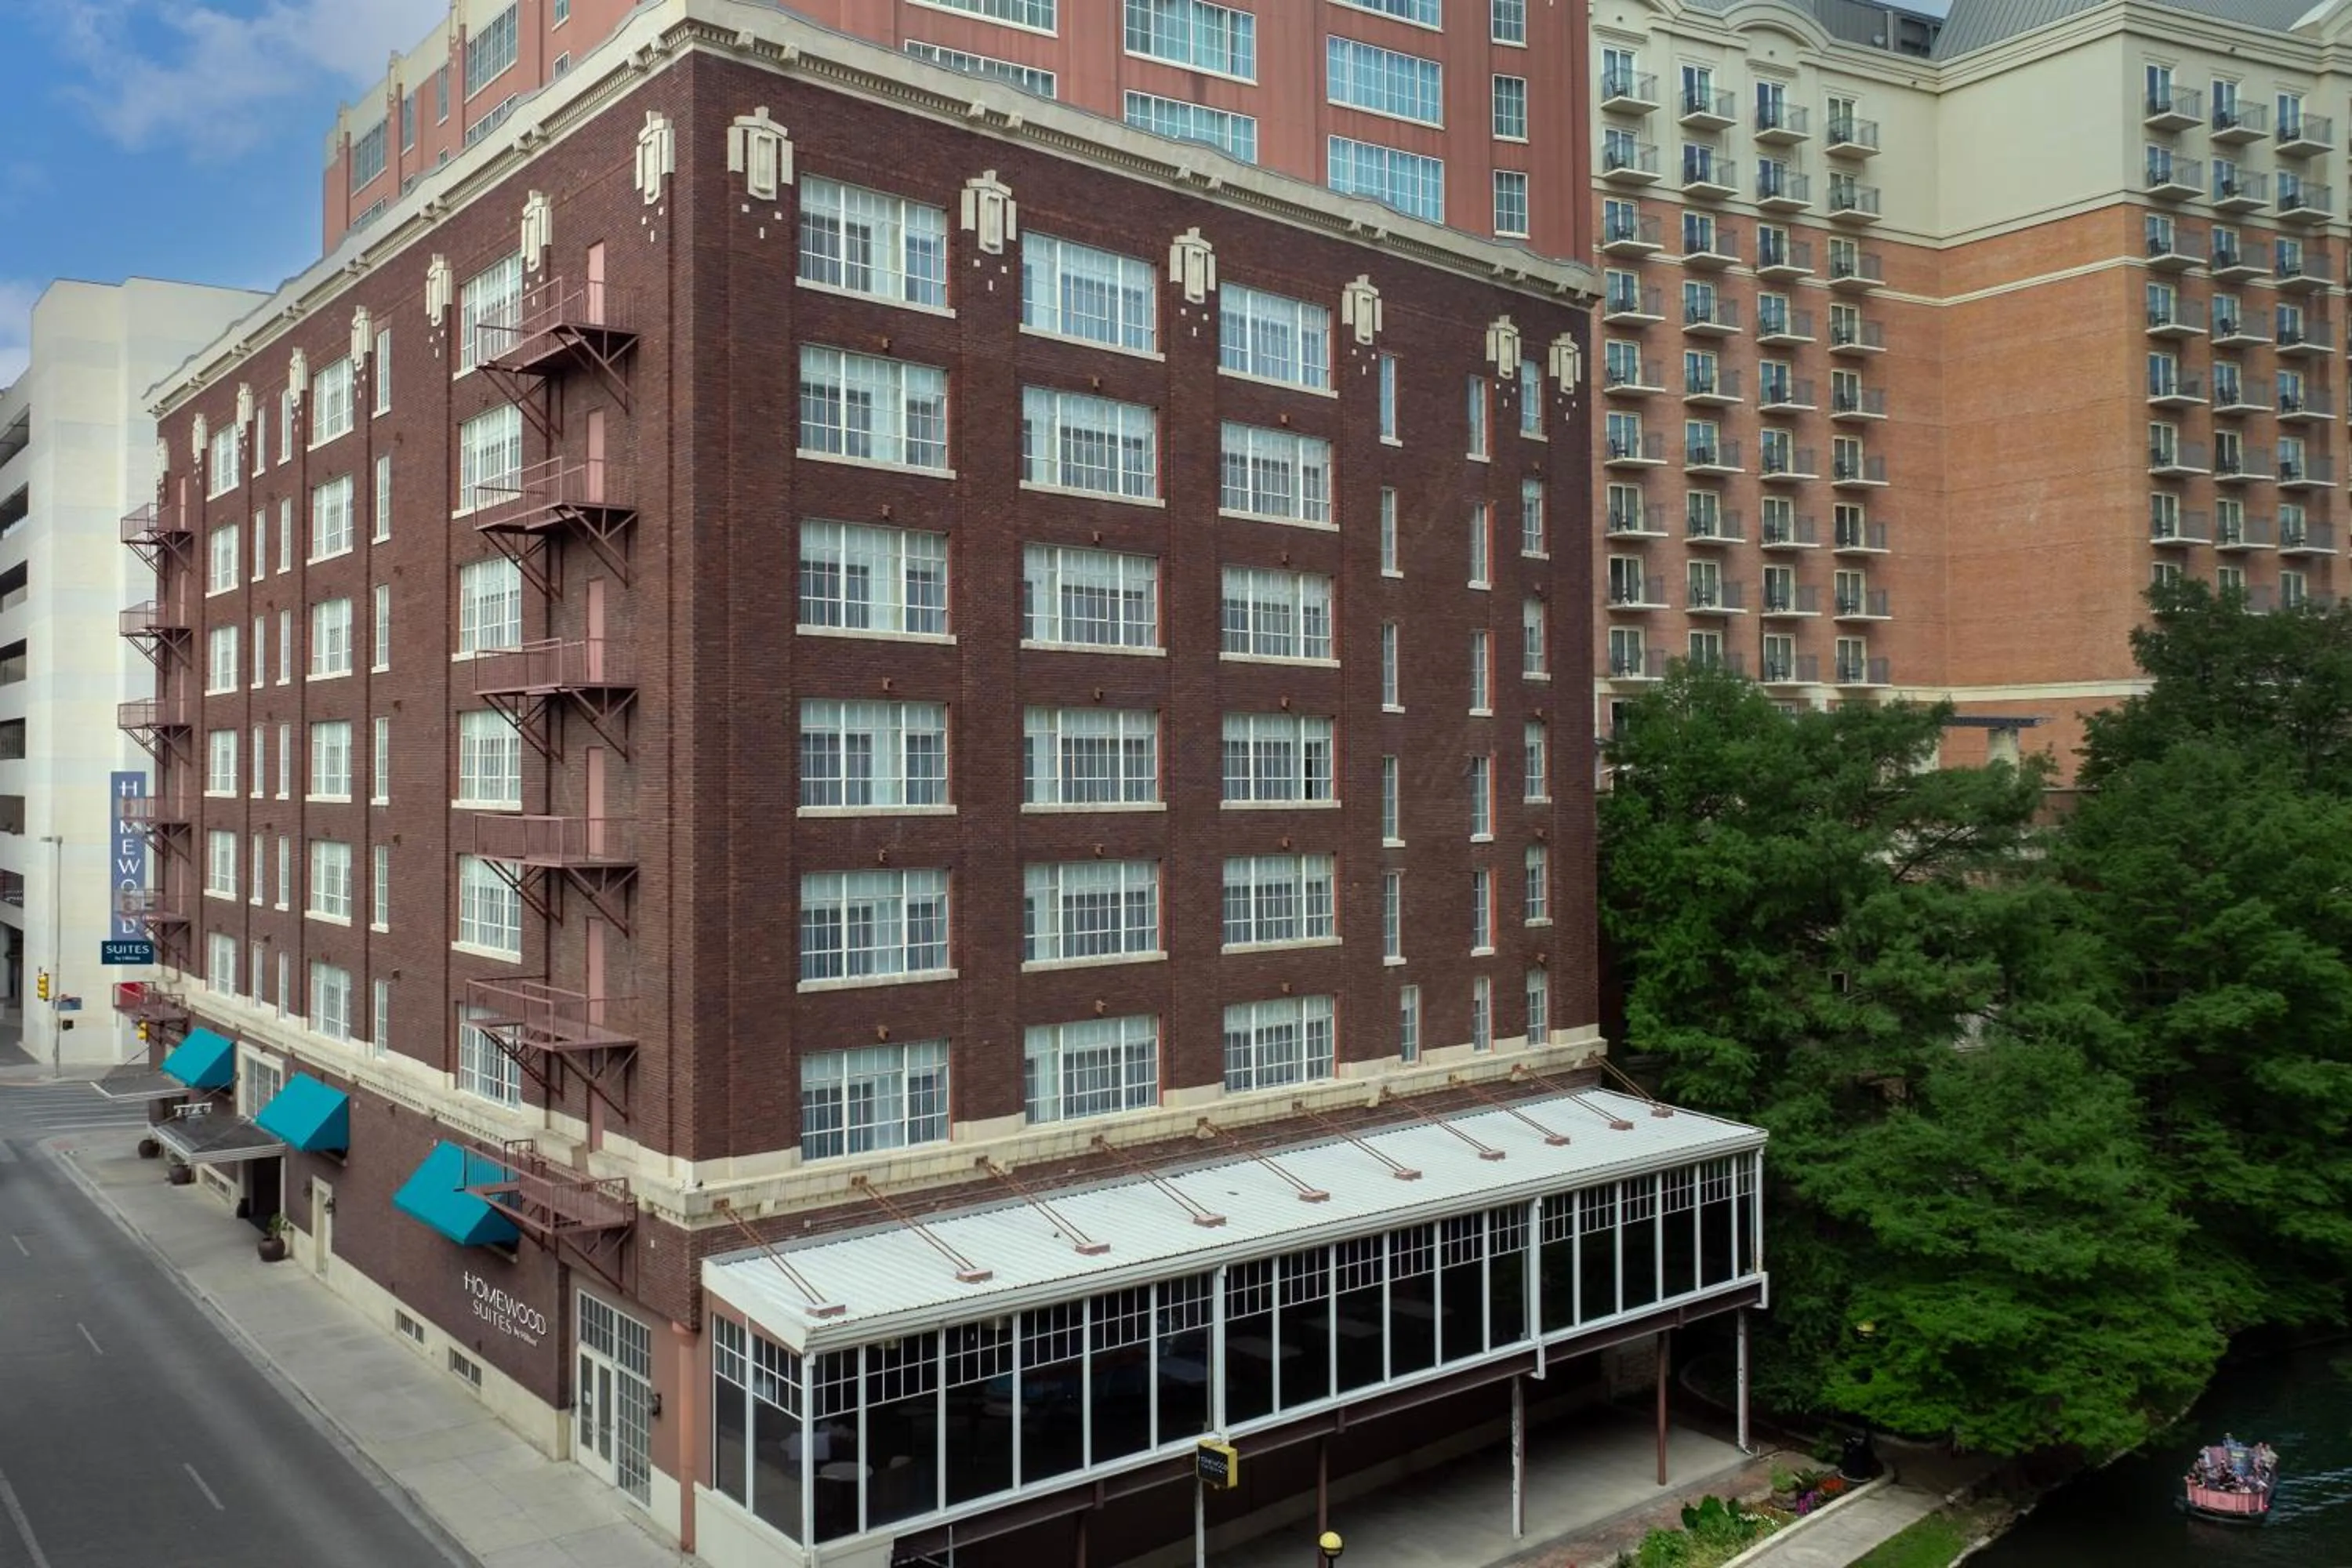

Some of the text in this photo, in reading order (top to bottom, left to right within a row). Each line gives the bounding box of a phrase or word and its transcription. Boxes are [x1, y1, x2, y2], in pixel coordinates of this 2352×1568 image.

[118, 780, 141, 935] HMEWOD
[106, 944, 150, 954] SUITES
[464, 1270, 546, 1335] HOMEWOOD
[472, 1299, 512, 1335] SUITES
